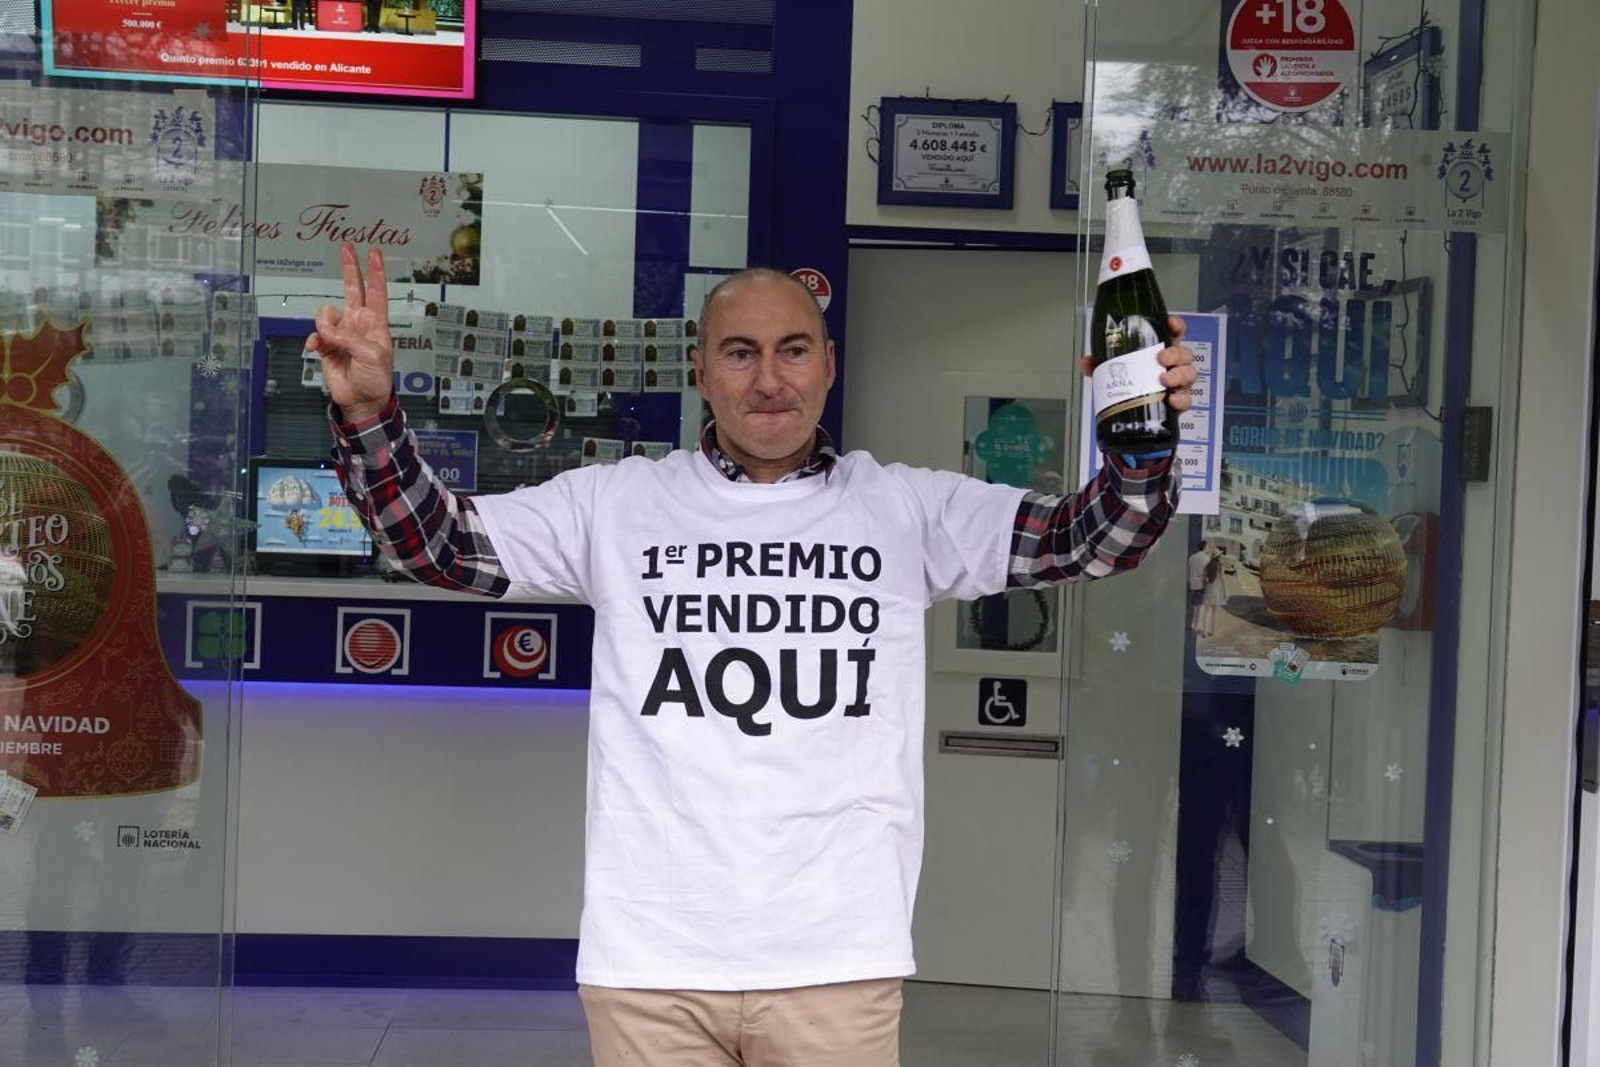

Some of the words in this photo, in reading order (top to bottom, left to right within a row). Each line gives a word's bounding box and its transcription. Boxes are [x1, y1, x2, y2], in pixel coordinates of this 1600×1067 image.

[1256, 0, 1326, 33] +18
[160, 53, 196, 65] Quinto
[198, 54, 235, 68] premio
[270, 60, 312, 72] vendido
[314, 63, 328, 72] en
[330, 63, 372, 74] Alicante
[0, 117, 134, 146] vigo.com
[909, 139, 977, 153] 4.608.445
[980, 144, 988, 153] €
[1187, 153, 1408, 182] www.la2vigo.com
[1322, 187, 1353, 197] 88580
[1459, 169, 1471, 193] 2
[295, 203, 413, 247] Fiestas
[1319, 250, 1376, 291] CAE
[641, 543, 688, 580] 1er
[696, 541, 883, 582] PREMIO
[642, 594, 881, 634] VENDIDO
[639, 637, 877, 737] AQUÍ
[4, 714, 111, 735] NAVIDAD
[0, 741, 63, 756] IEMBRE
[143, 828, 190, 840] LOTERÍA
[143, 839, 202, 850] NACIONAL
